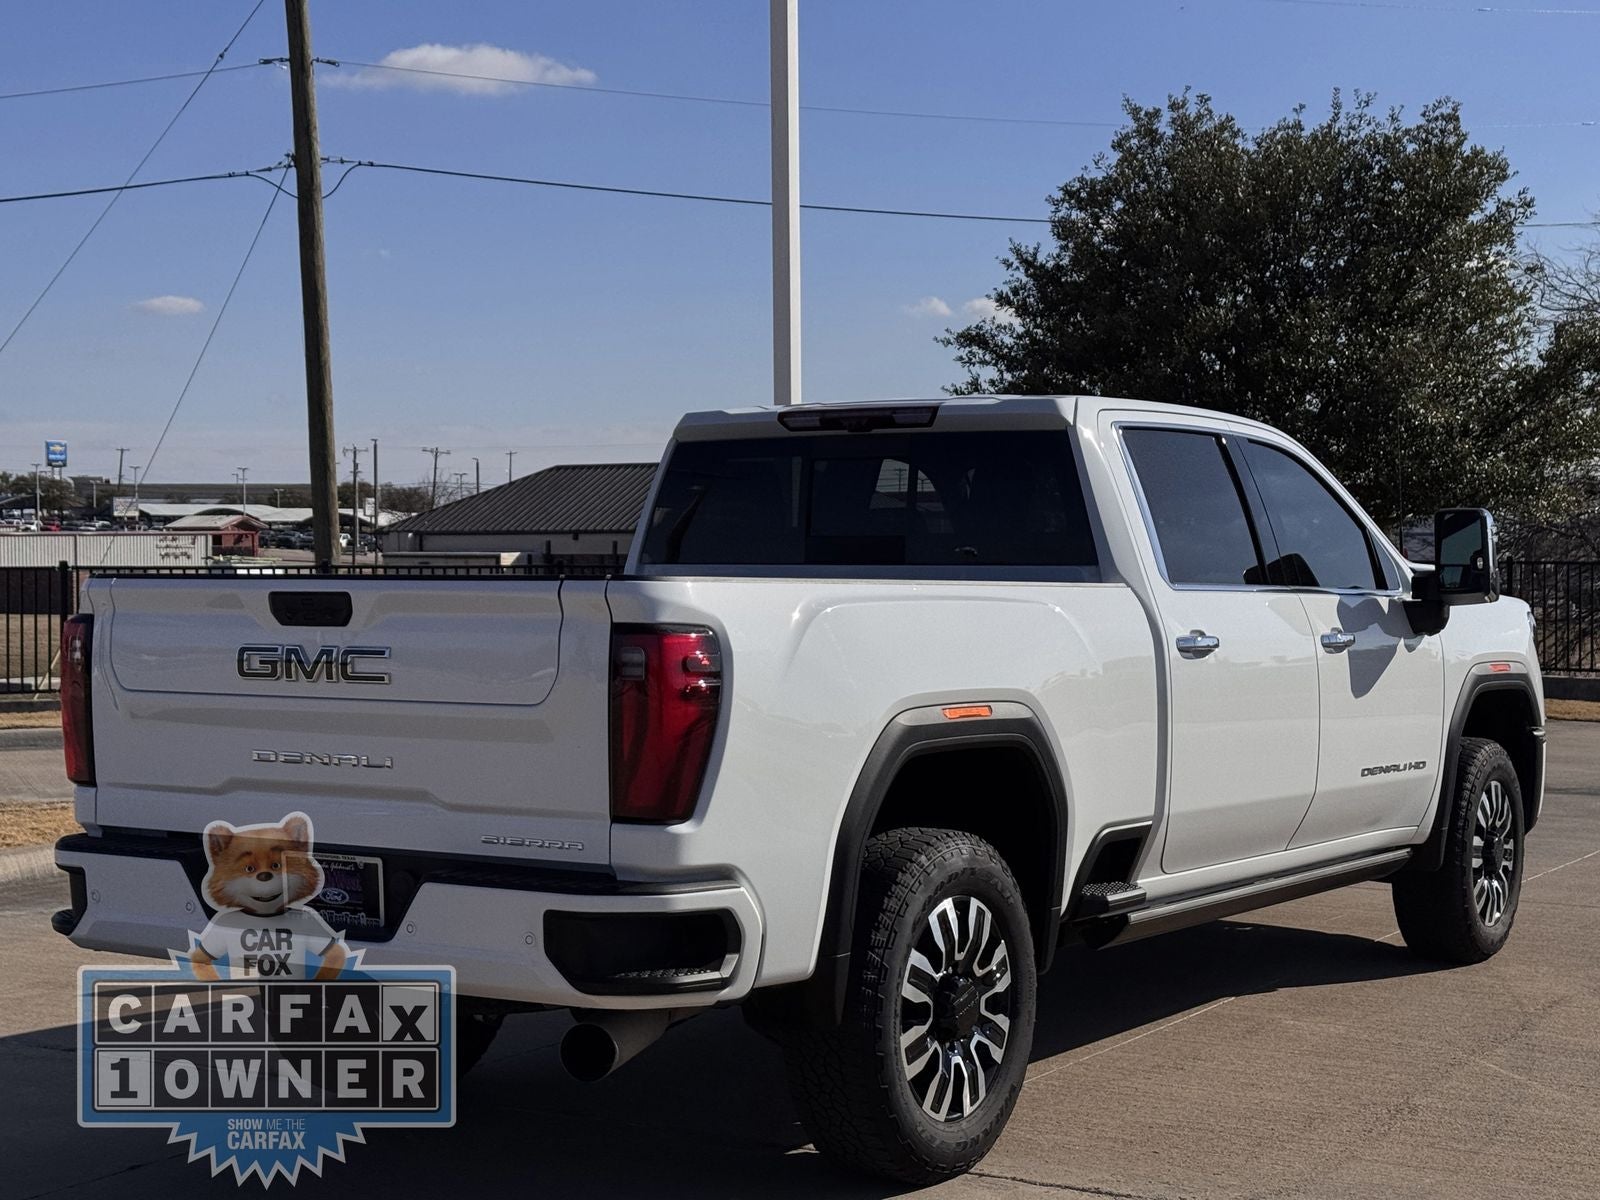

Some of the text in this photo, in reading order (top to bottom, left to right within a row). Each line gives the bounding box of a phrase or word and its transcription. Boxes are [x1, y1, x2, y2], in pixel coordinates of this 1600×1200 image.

[237, 644, 391, 685] GMC
[252, 750, 393, 769] DENALI
[1360, 761, 1427, 777] DENALI HD
[481, 835, 584, 851] SIERRA
